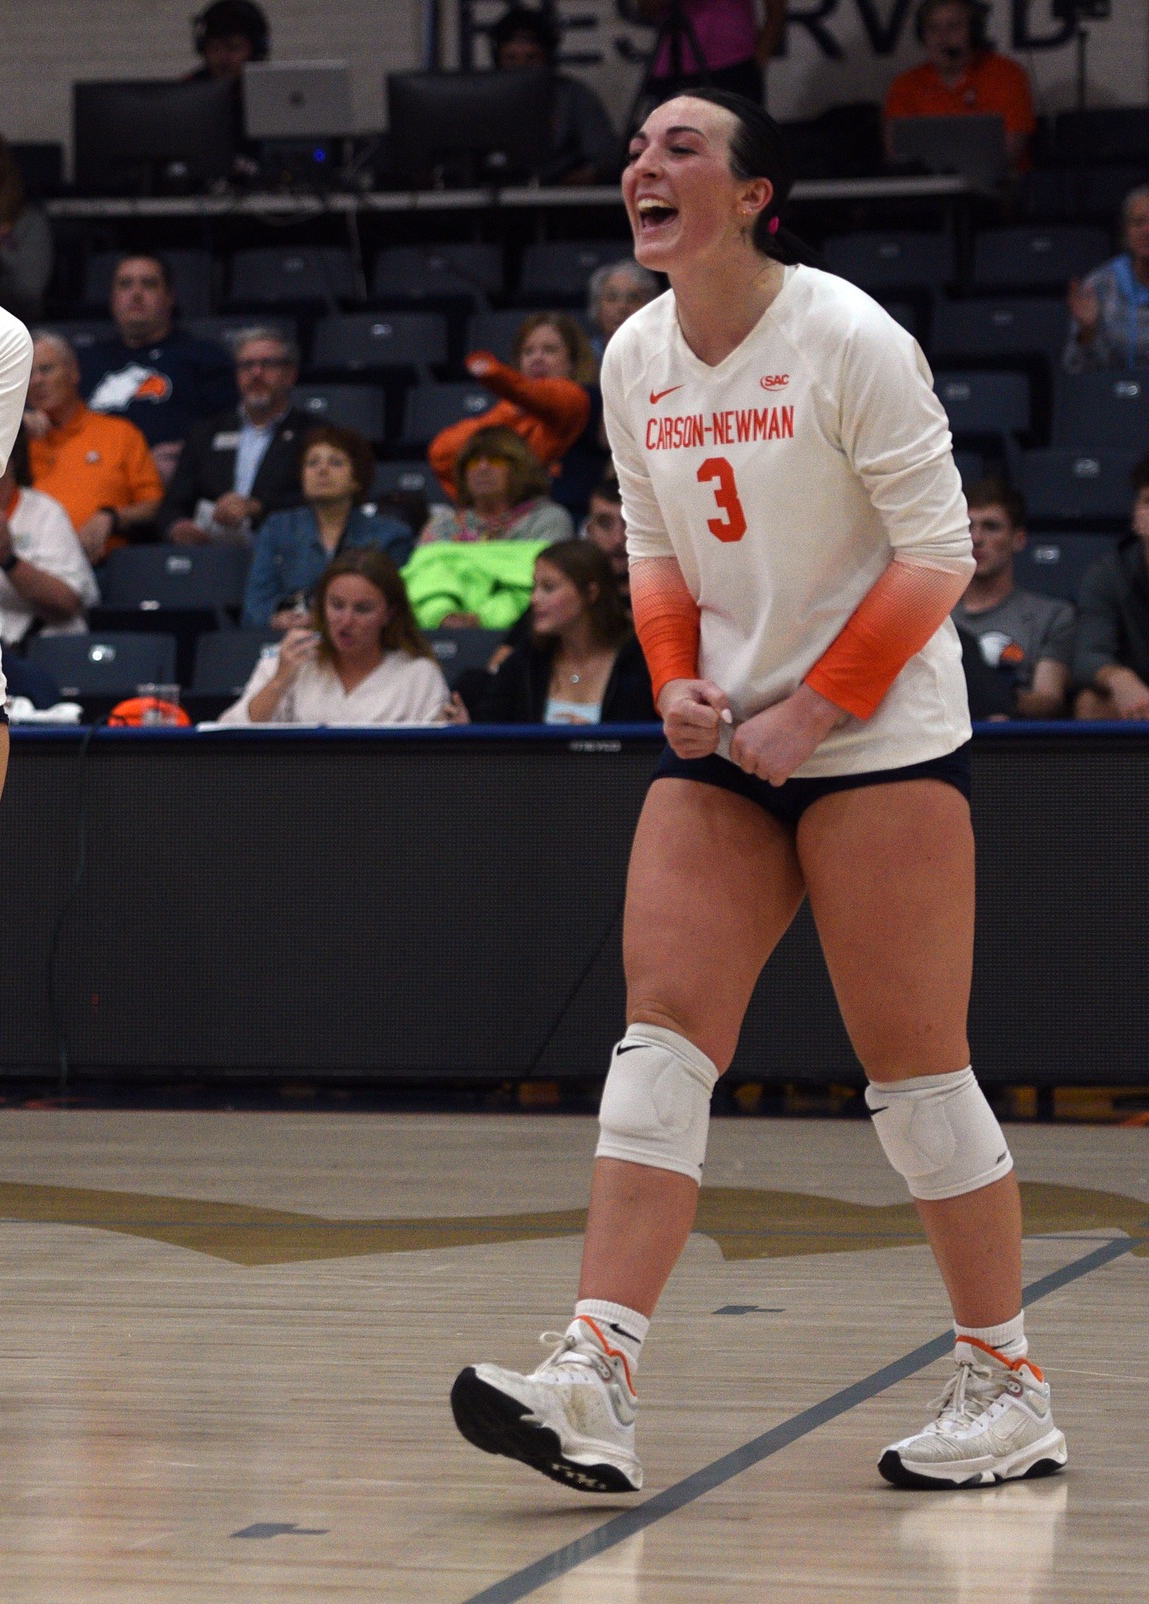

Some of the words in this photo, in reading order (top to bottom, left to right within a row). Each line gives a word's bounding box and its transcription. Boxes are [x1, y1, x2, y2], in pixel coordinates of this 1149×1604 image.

[763, 374, 790, 388] SAC
[645, 405, 795, 450] CARSON-NEWMAN
[697, 457, 748, 542] 3
